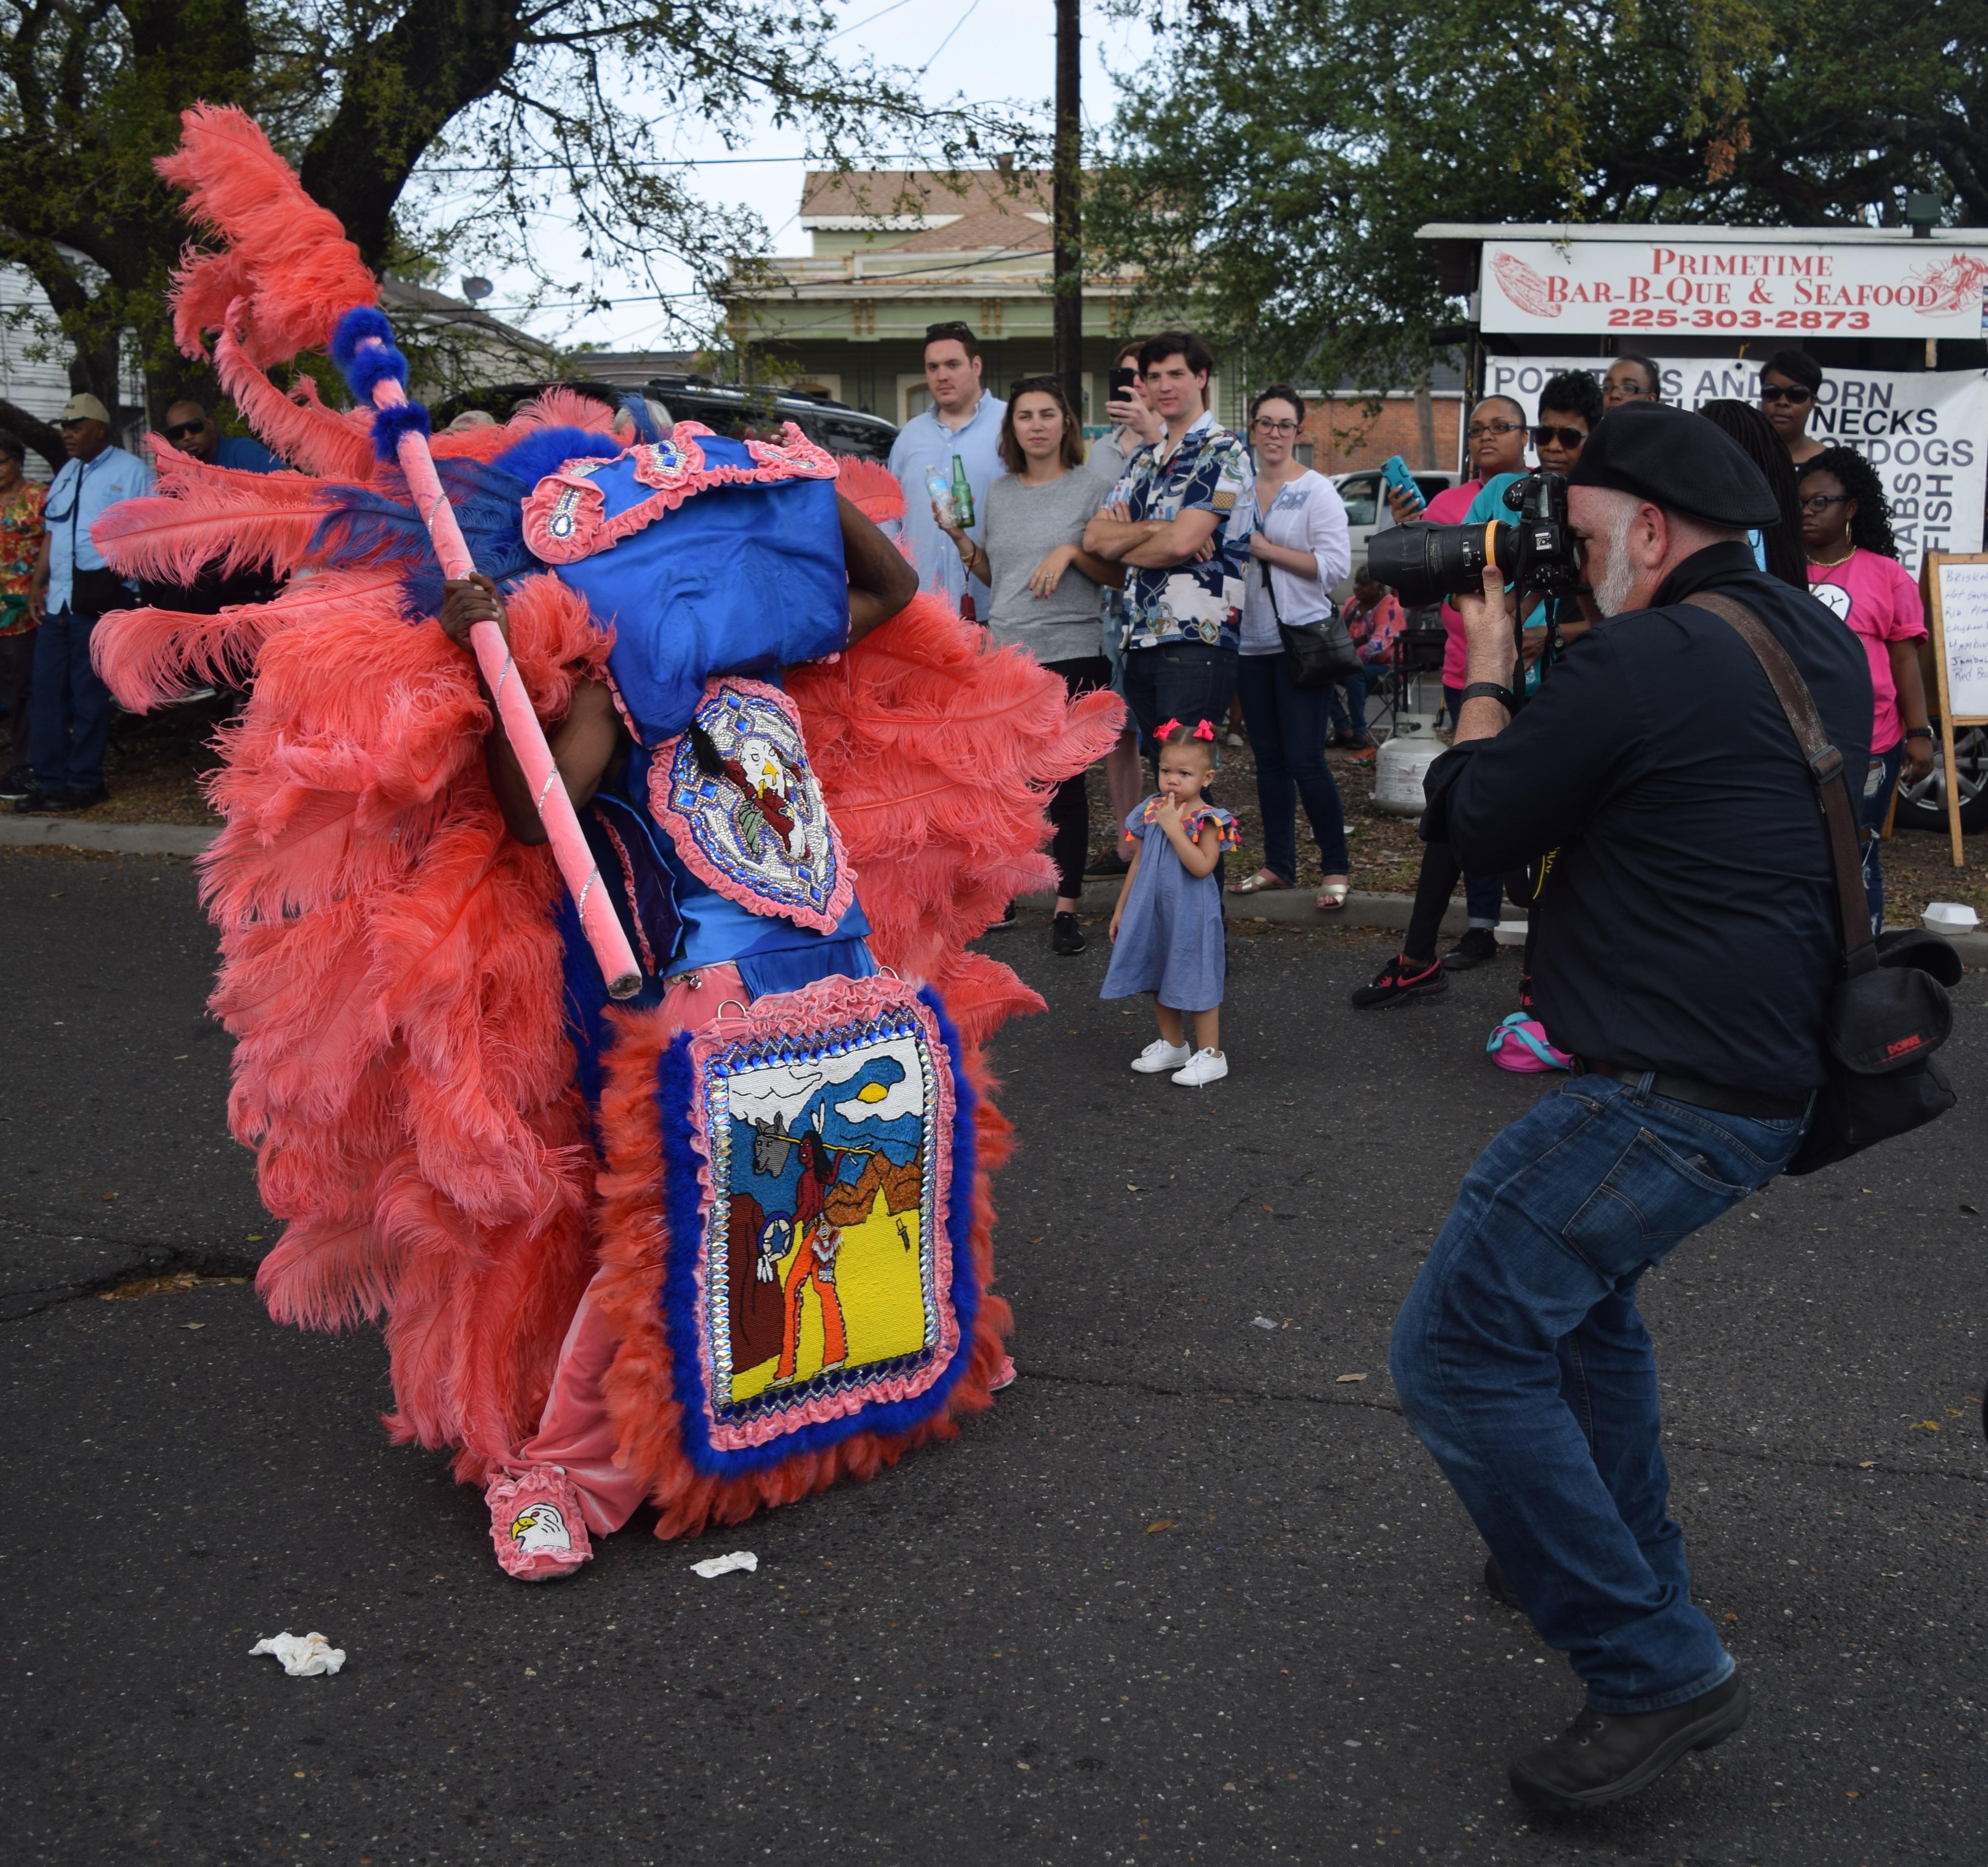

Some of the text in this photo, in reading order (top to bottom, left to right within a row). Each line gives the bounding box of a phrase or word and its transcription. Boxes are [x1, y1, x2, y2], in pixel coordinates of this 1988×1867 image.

[1650, 248, 1833, 277] PRIMETIME
[1545, 276, 1938, 307] BAR-B-QUE & SEAFOOD
[1607, 308, 1870, 329] 225-303-2873
[1811, 406, 1938, 436] NECKS
[1923, 474, 1953, 554] FISH
